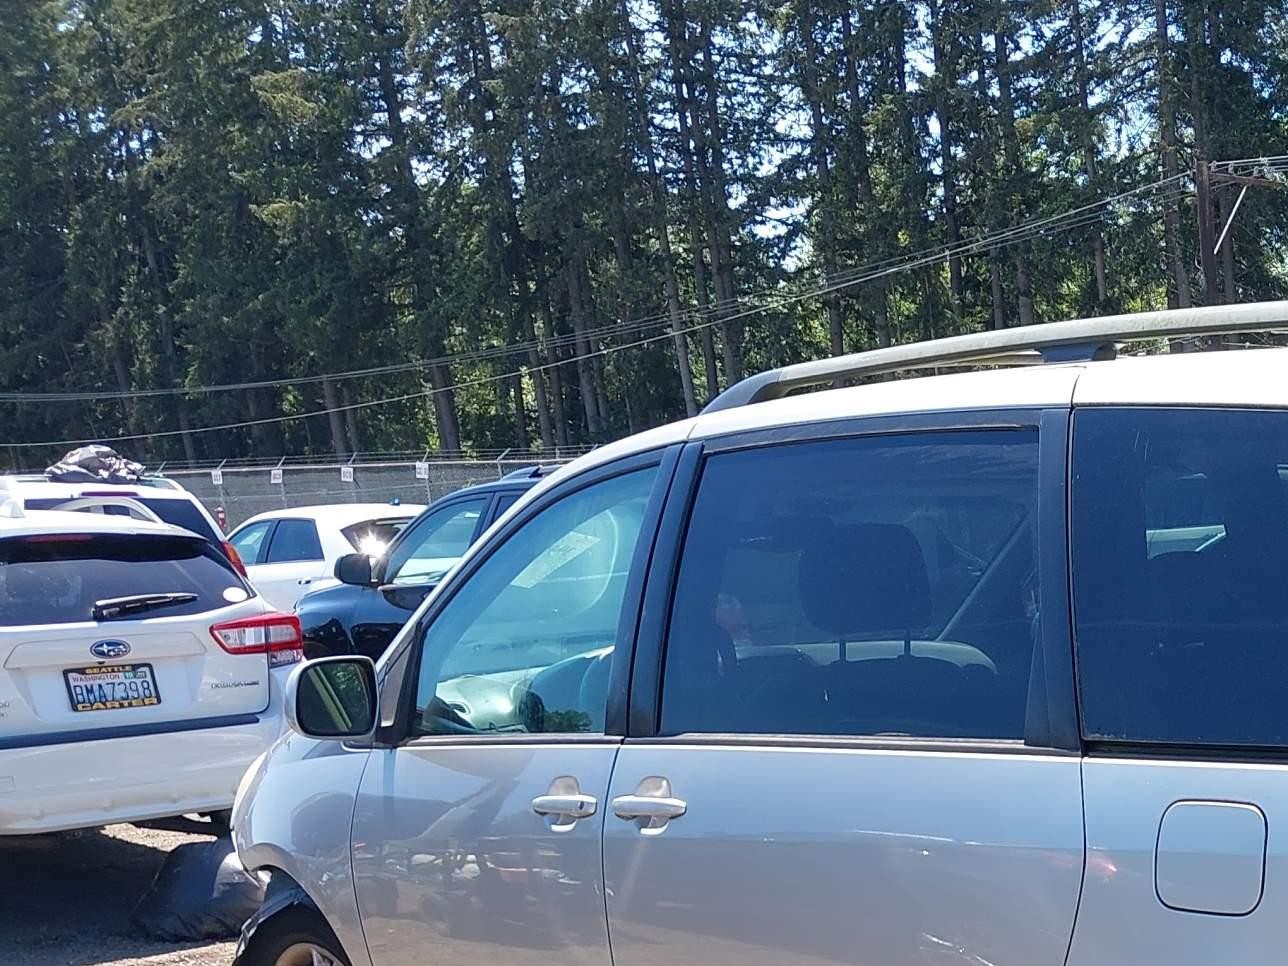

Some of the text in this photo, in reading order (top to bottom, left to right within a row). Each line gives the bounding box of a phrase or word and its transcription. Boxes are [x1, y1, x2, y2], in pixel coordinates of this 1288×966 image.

[85, 665, 132, 674] SEATTLE
[72, 673, 120, 682] WASHINGTON
[73, 680, 152, 704] BMA7398
[77, 697, 158, 711] CARTER
